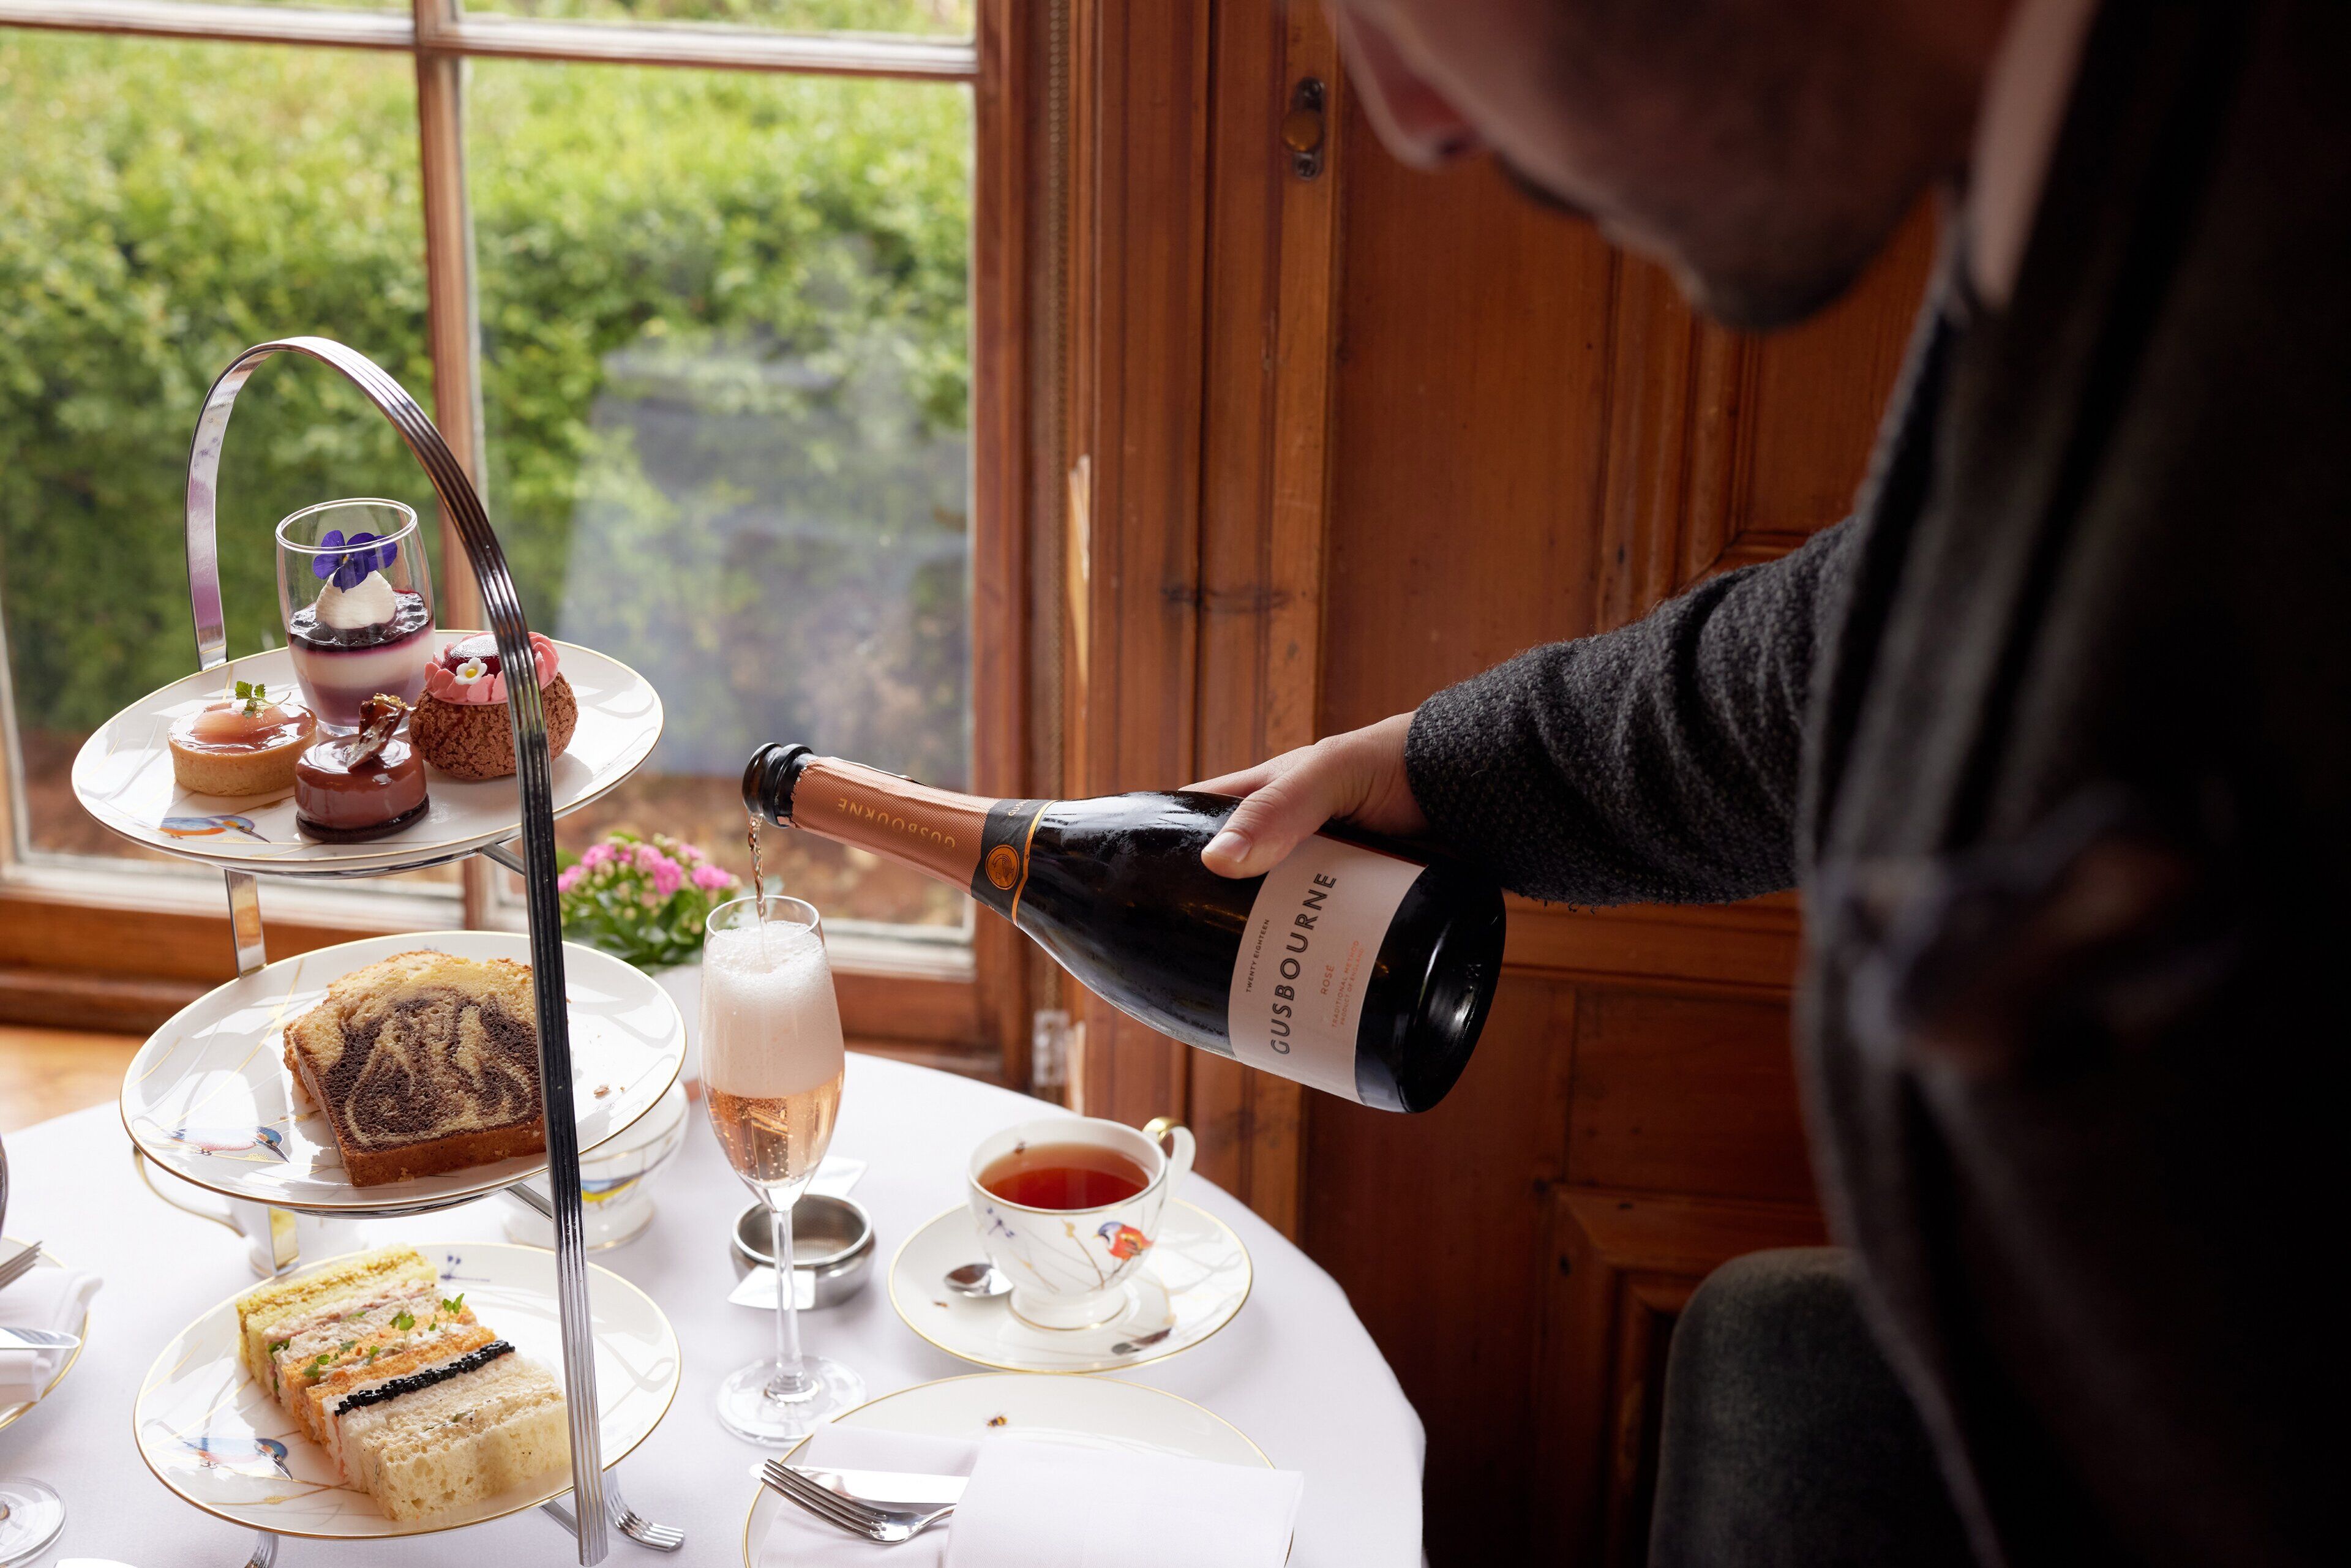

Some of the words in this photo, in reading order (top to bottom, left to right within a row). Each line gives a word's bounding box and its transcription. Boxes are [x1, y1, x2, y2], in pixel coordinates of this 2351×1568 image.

[838, 798, 956, 849] GUSBOURNE
[1246, 961, 1257, 992] TWENTY
[1253, 919, 1270, 958] EIGHTEEN
[1270, 873, 1337, 1054] GUSBOURNE
[1320, 965, 1335, 995] ROSÉ
[1332, 977, 1348, 1027] TRADITIONAL
[1344, 940, 1359, 973] METHOD
[1340, 994, 1351, 1025] PRODUCT
